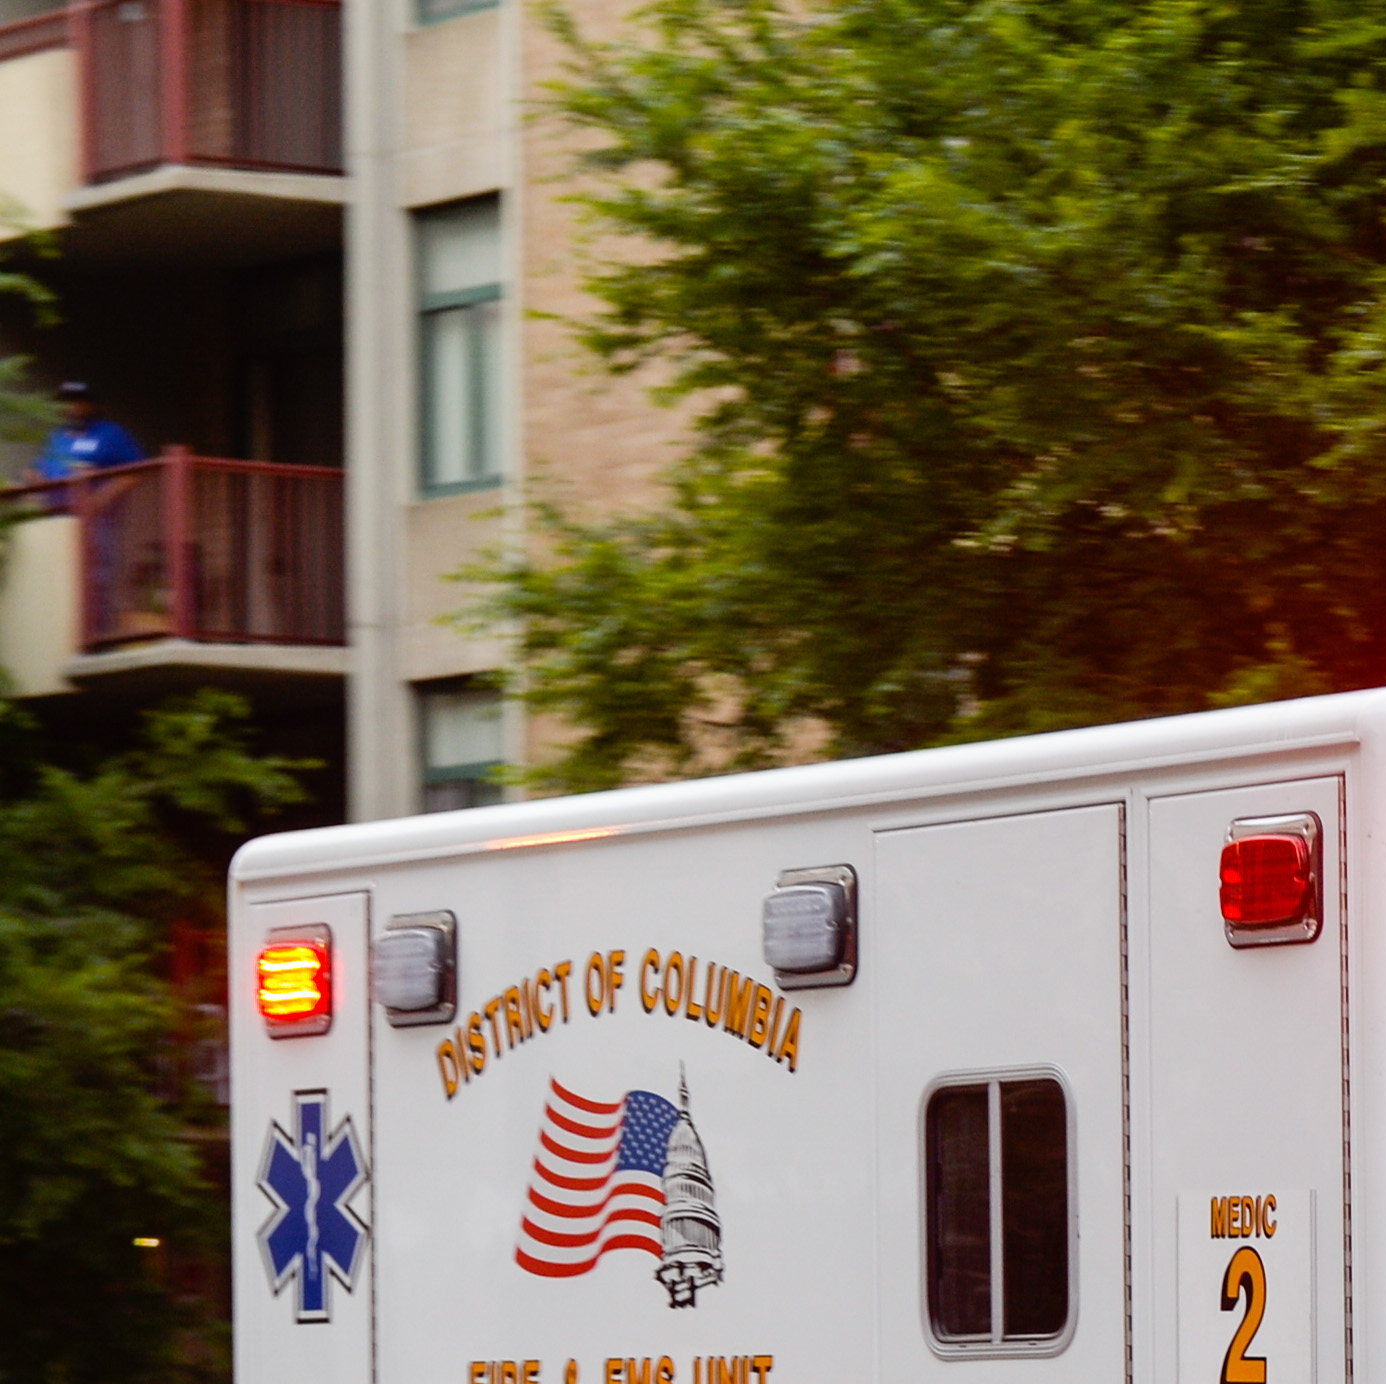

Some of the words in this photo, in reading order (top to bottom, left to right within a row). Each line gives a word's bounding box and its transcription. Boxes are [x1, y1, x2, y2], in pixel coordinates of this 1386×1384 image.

[437, 960, 572, 1100] DISTRICT
[586, 949, 625, 1017] OF
[640, 947, 803, 1073] COLUMBIA
[1210, 1194, 1277, 1239] MEDIC
